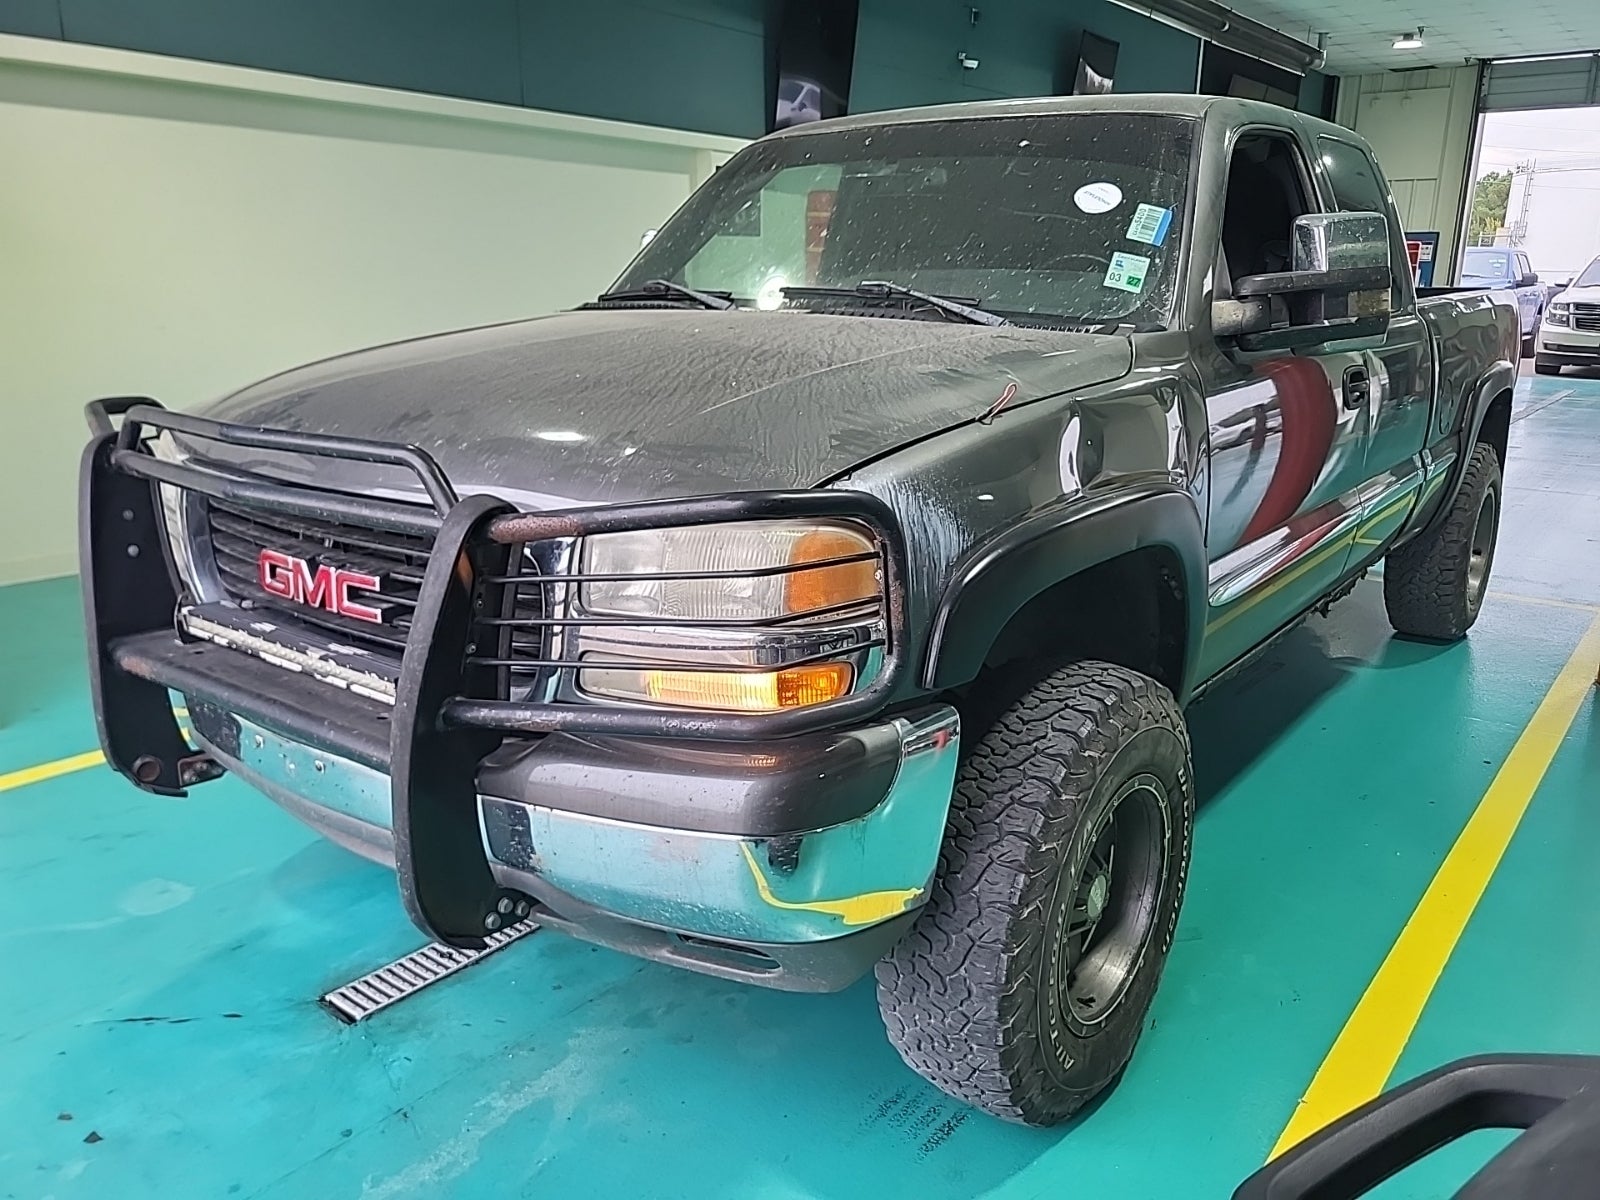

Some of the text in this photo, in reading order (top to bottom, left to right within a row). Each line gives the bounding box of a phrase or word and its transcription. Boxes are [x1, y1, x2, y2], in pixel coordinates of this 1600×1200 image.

[1109, 272, 1122, 282] 03
[1127, 277, 1141, 287] 27
[259, 549, 382, 624] GMC
